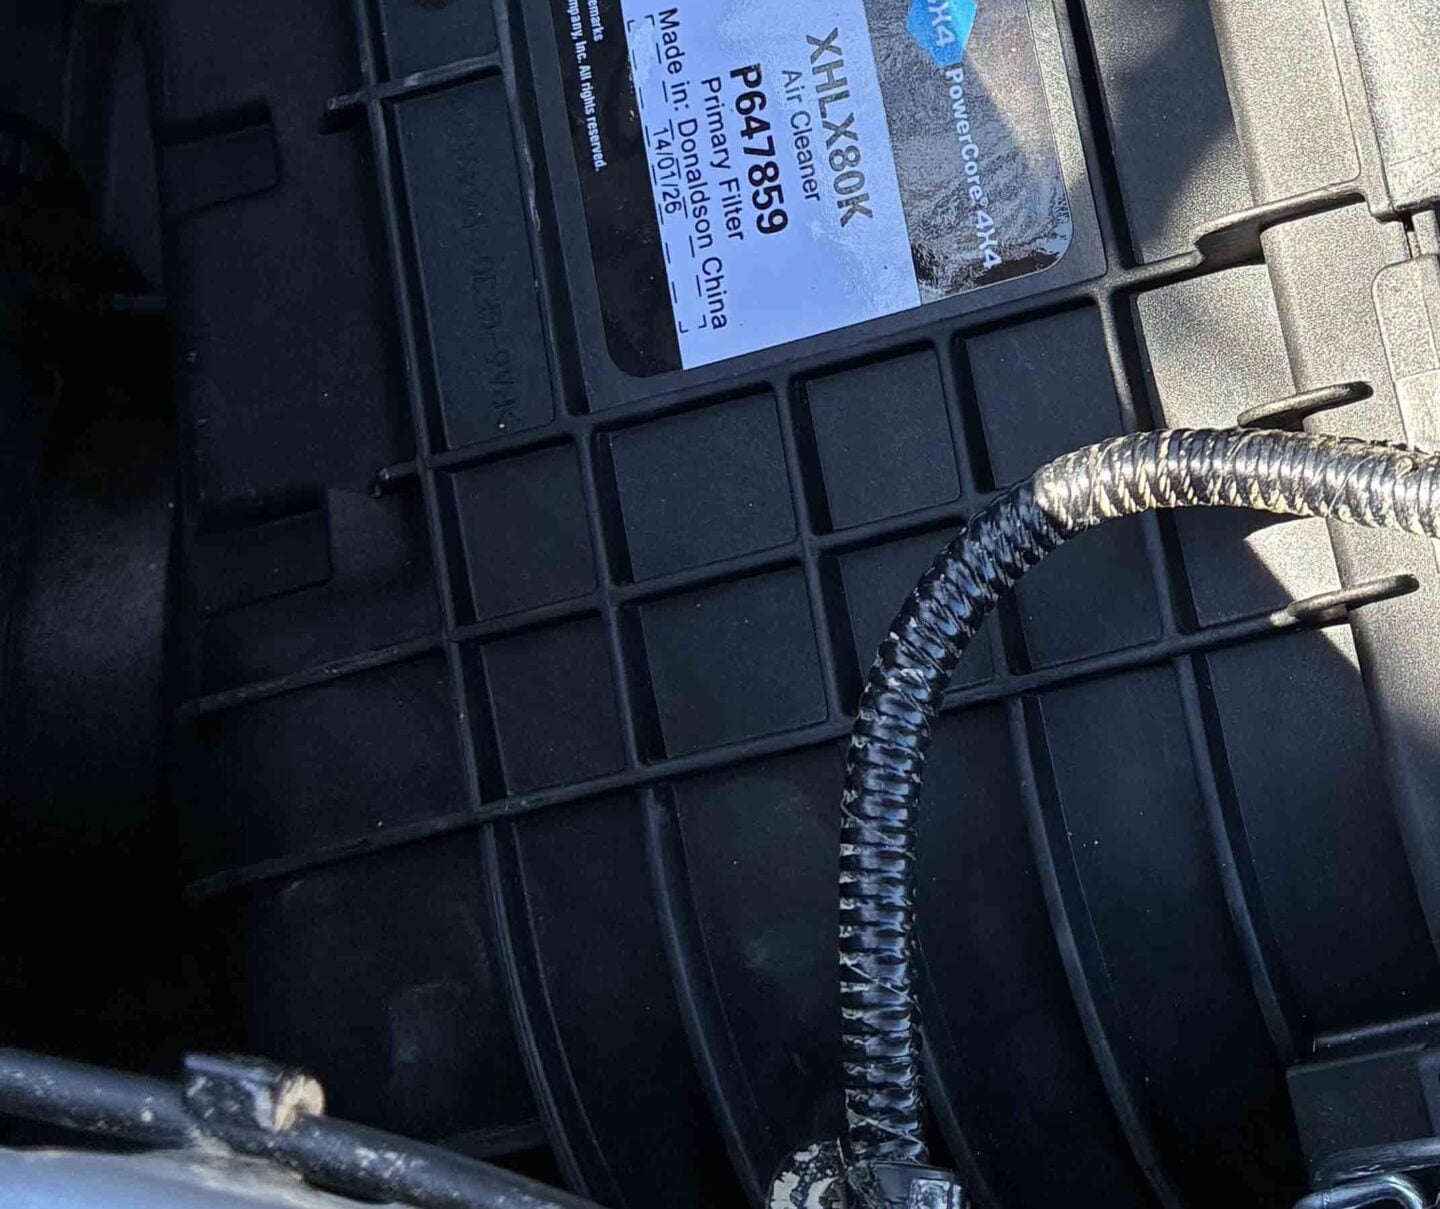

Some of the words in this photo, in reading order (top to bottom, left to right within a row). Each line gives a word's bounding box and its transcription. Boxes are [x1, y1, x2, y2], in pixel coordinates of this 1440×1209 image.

[575, 41, 587, 63] Inc.
[579, 66, 592, 80] All
[659, 8, 685, 74] Made
[580, 82, 595, 114] rights
[671, 81, 690, 111] in:
[782, 70, 805, 102] Air
[587, 117, 607, 171] reserved.
[701, 77, 731, 169] Primary
[719, 178, 743, 240] Filter
[730, 63, 788, 234] P647859
[791, 111, 820, 201] Cleaner
[806, 27, 873, 228] XHLX80K
[653, 128, 685, 213] 14/01/26
[678, 118, 713, 248] Donaldson
[970, 207, 1003, 270] 4X4
[702, 257, 727, 329] China
